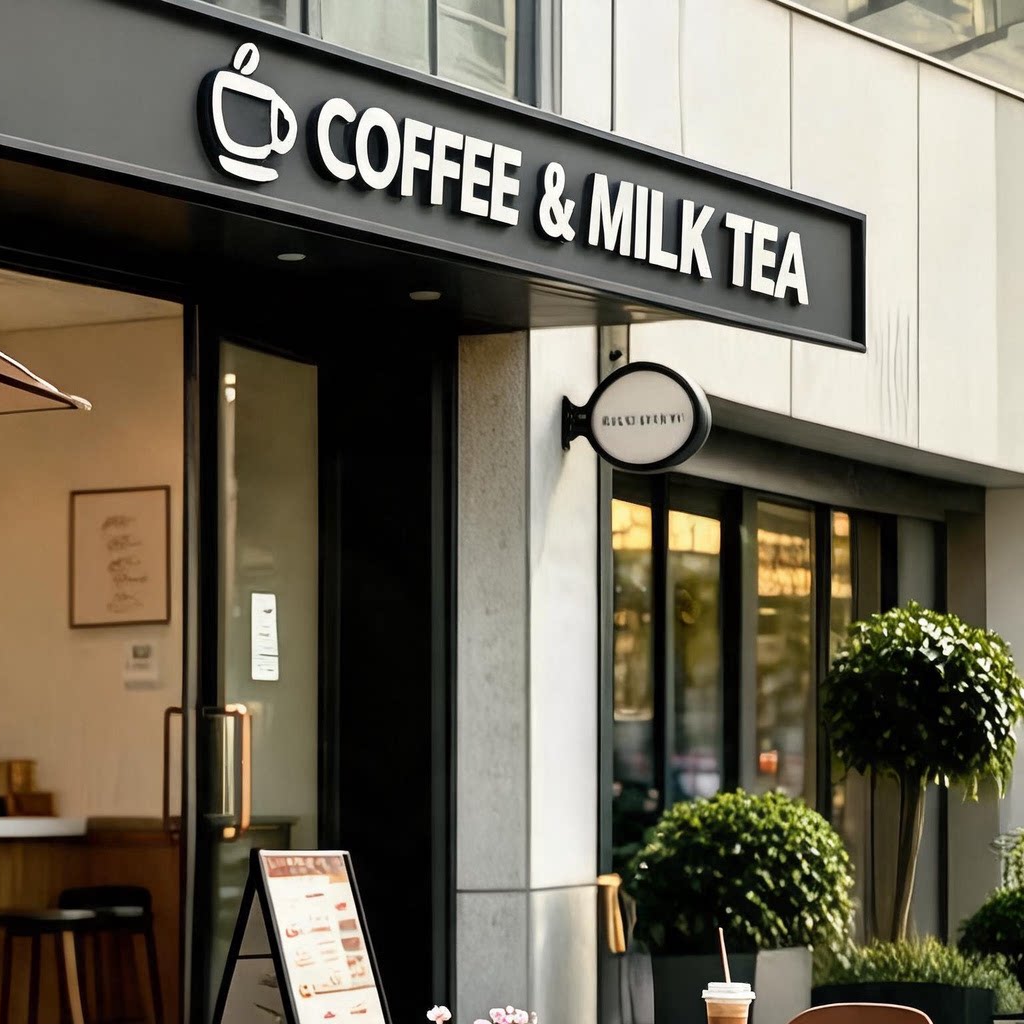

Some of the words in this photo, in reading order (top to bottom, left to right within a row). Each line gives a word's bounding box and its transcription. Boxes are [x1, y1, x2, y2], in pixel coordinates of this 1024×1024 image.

[316, 97, 522, 225] COFFEE
[538, 162, 575, 241] &
[588, 173, 714, 279] MILK
[724, 212, 809, 305] TEA
